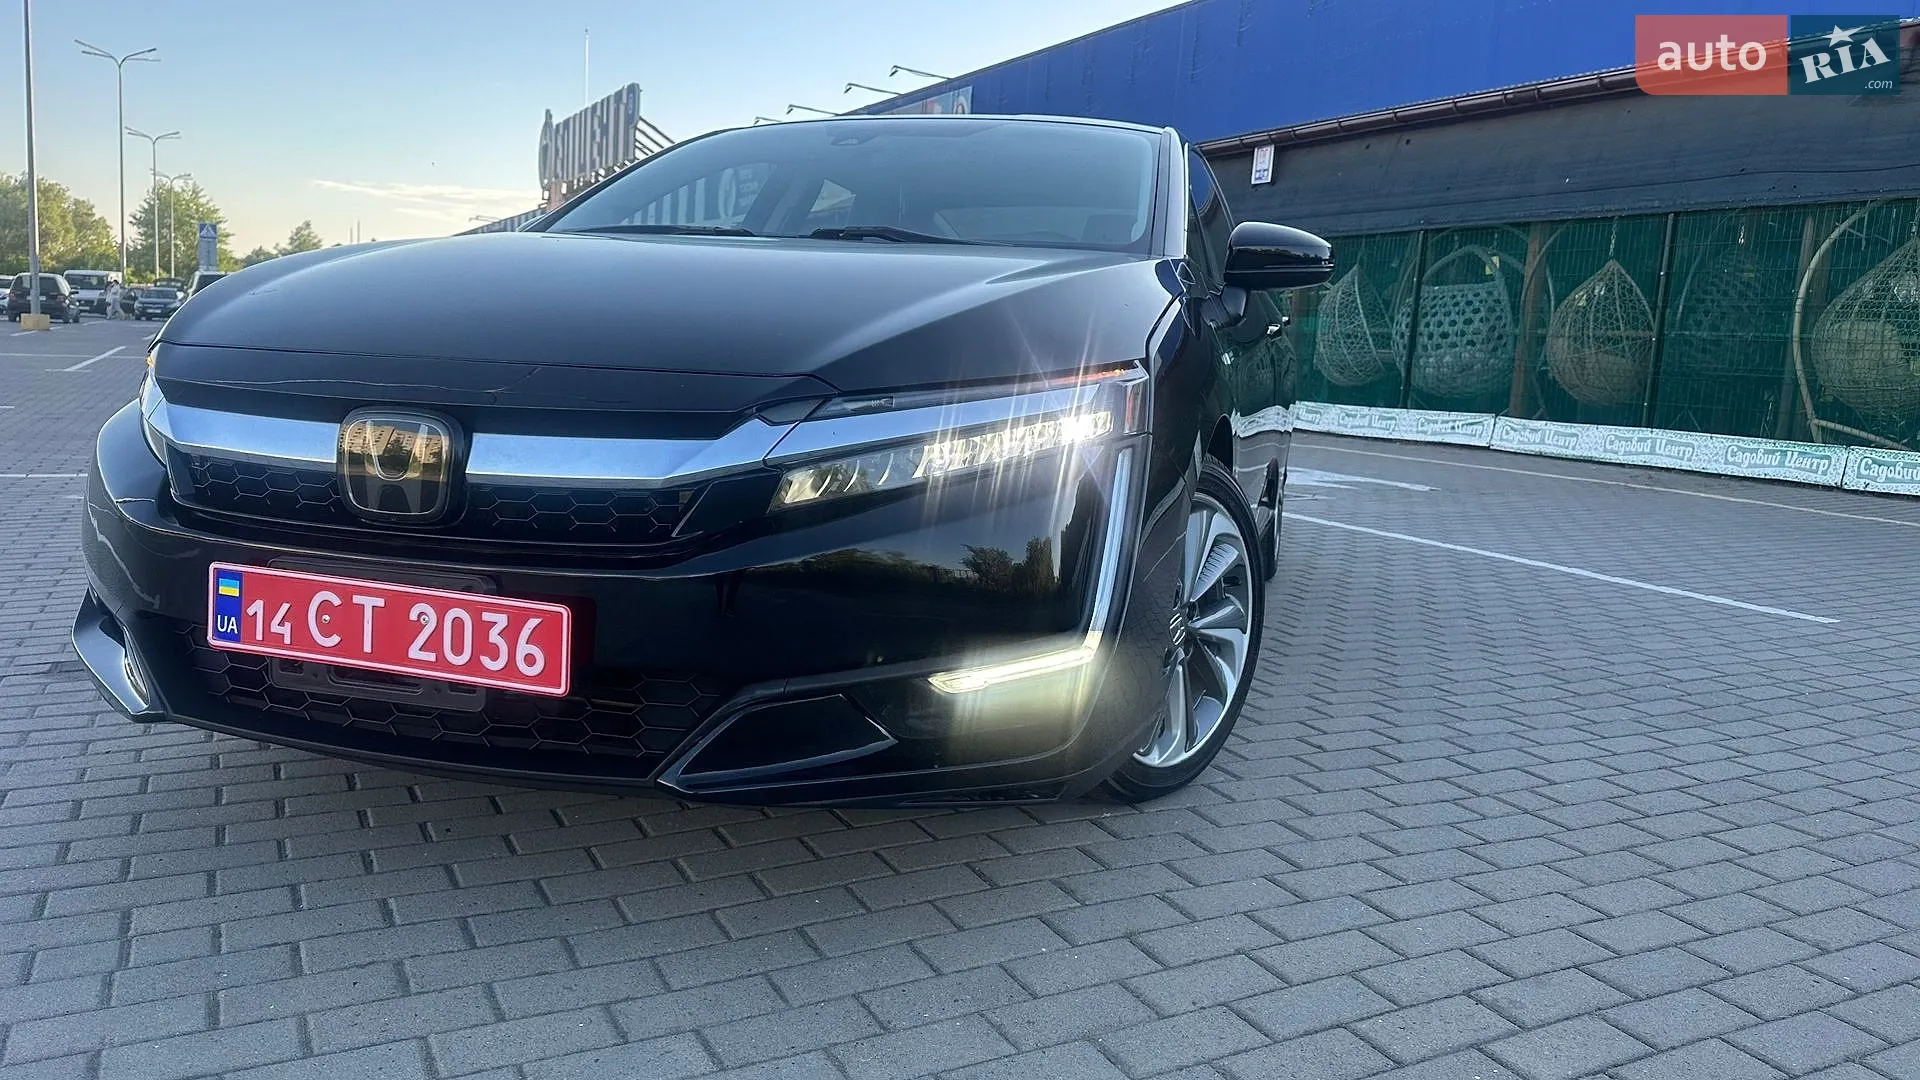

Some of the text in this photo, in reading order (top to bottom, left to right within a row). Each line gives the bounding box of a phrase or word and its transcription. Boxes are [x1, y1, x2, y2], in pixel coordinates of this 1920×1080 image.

[1606, 434, 1694, 462] Садовий Центр
[1726, 446, 1829, 475] Садовий Центр
[217, 614, 239, 634] UA
[246, 599, 292, 645] 14
[408, 602, 546, 677] 2036
